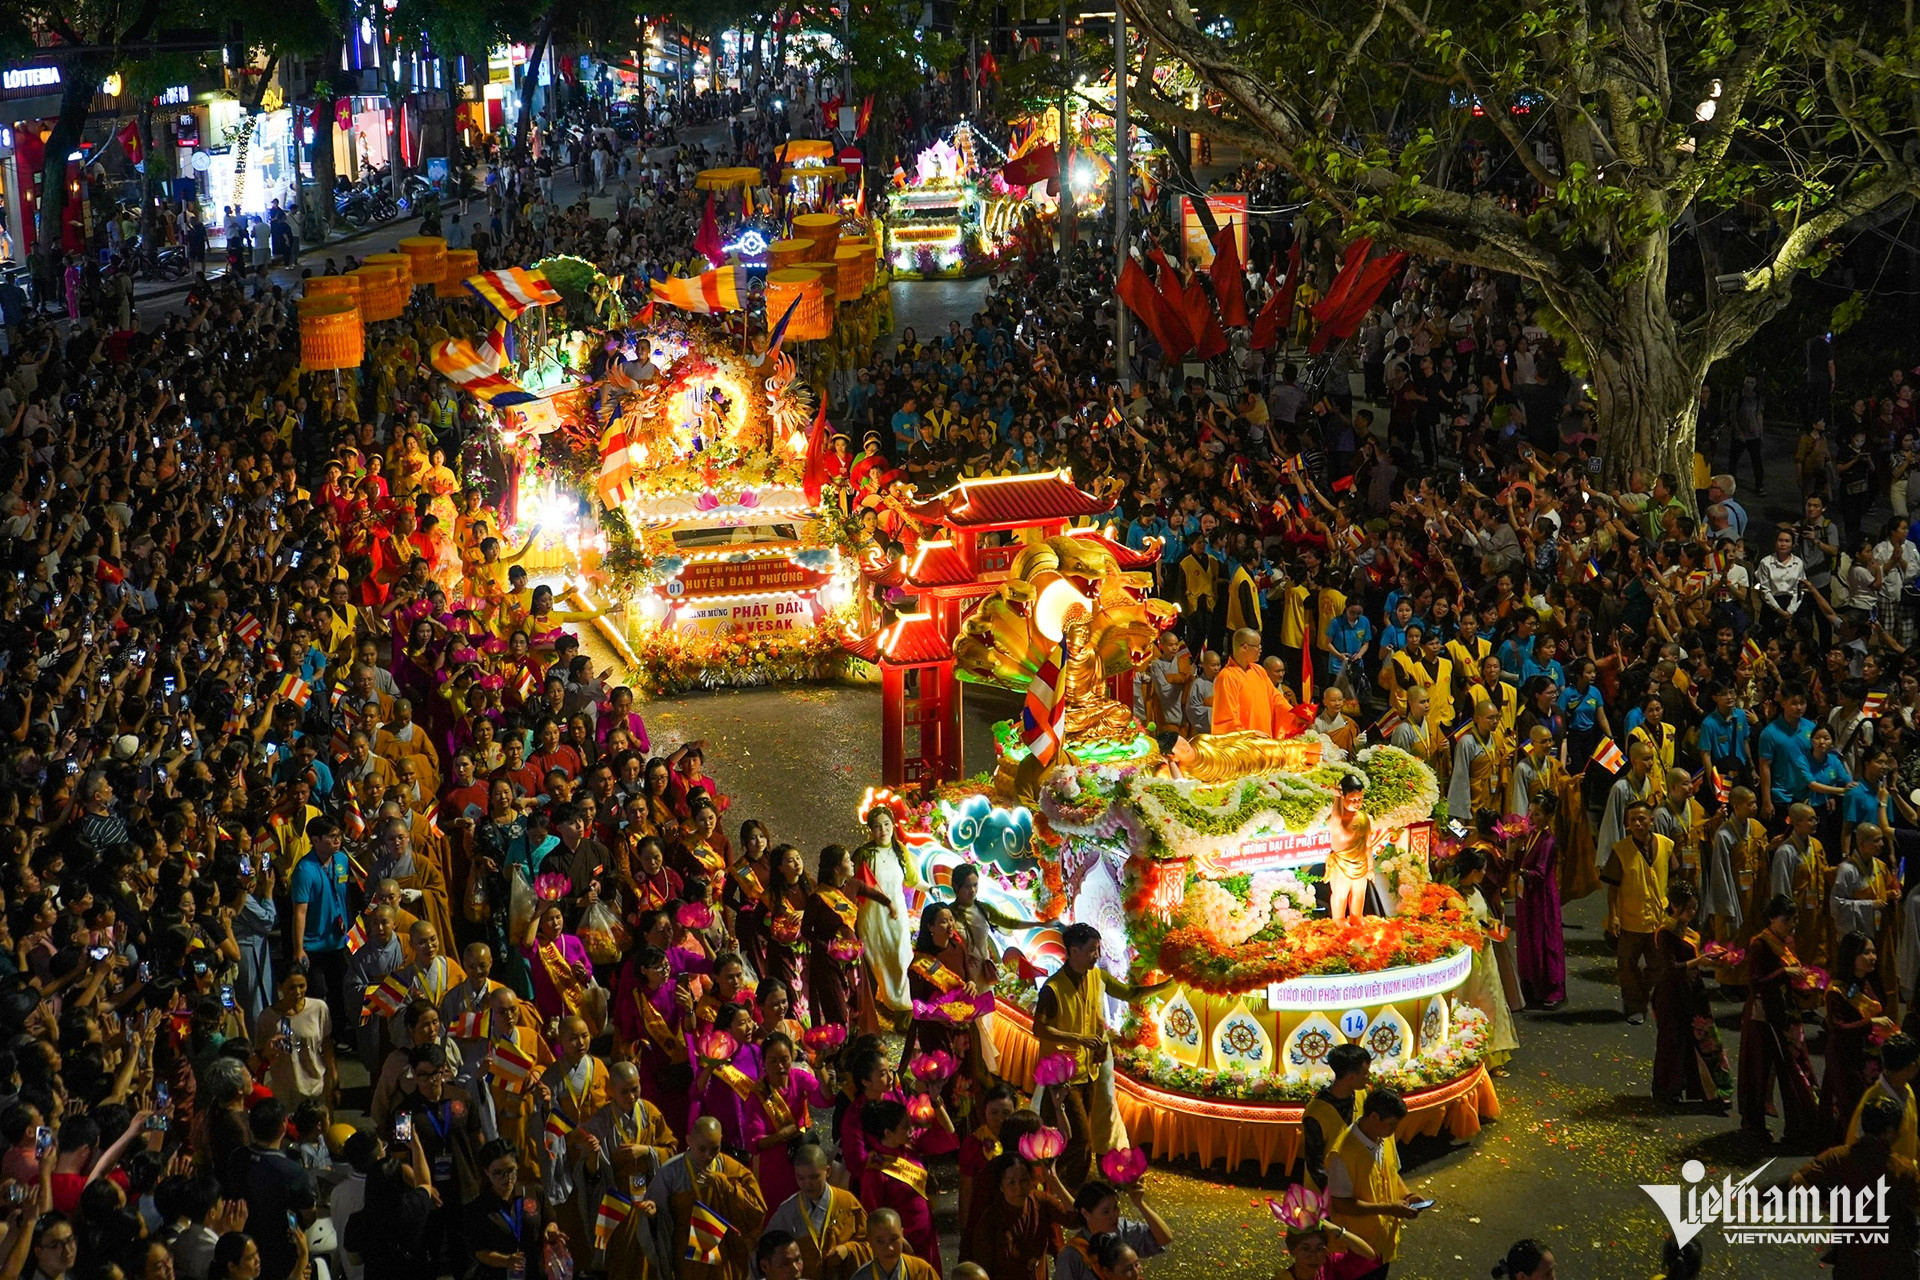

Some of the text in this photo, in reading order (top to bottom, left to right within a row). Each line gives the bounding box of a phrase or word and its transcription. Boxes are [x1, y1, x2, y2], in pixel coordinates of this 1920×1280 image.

[3, 66, 61, 90] LOTTERIA
[725, 564, 740, 574] PHẬT
[742, 562, 756, 572] GIÁO
[758, 562, 771, 572] VIỆT
[773, 561, 788, 570] NAM
[669, 583, 681, 594] 01
[685, 571, 804, 591] HUYỆN ĐAN PHƯỢNG
[707, 606, 728, 618] MỪNG
[732, 597, 804, 621] PHẬT ĐẢN
[746, 618, 793, 633] VESAK
[1269, 840, 1284, 854] ĐẠI
[1284, 837, 1295, 850] LỄ
[1296, 833, 1317, 849] PHẬT
[1277, 985, 1298, 1002] GIÁO
[1300, 985, 1317, 1005] HỘI
[1318, 984, 1341, 1005] PHẬT
[1343, 983, 1363, 1001] GIÁO
[1364, 980, 1382, 1001] VIỆT
[1383, 980, 1401, 995] NAM
[1401, 973, 1426, 993] HUYỆN
[1345, 1015, 1364, 1032] 14
